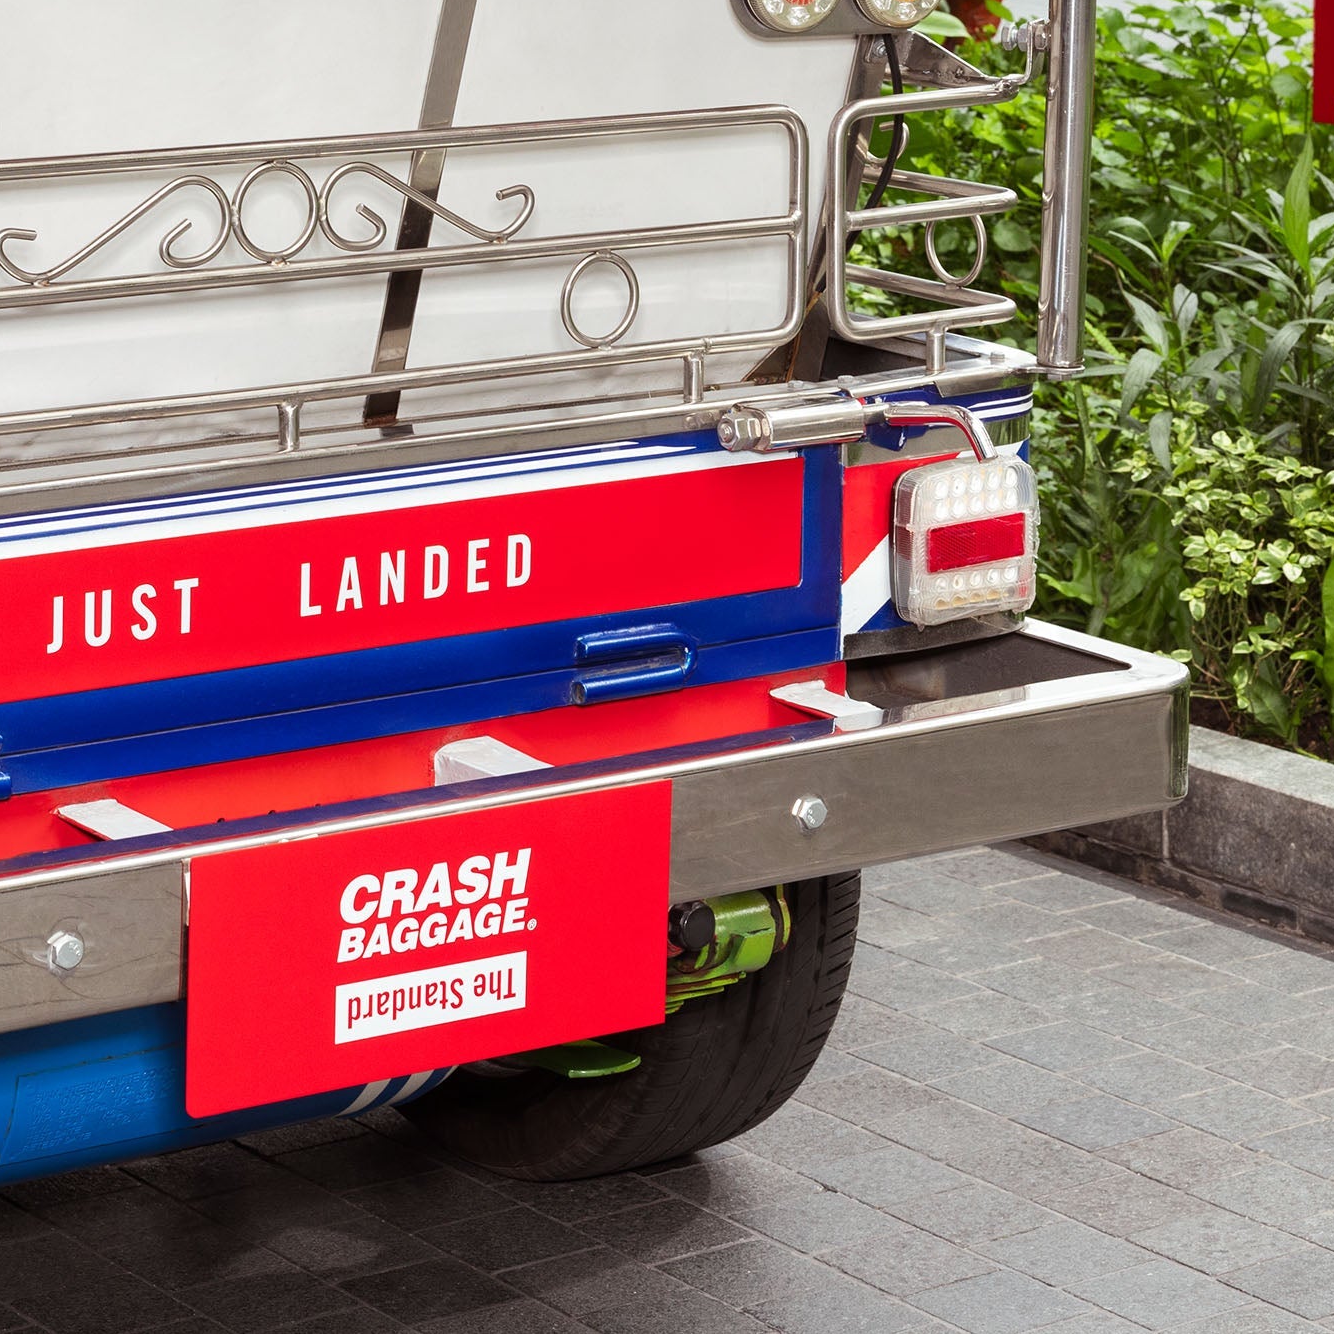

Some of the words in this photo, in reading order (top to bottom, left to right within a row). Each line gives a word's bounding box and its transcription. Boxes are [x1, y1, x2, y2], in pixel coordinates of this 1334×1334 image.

[46, 577, 199, 654] JUST
[300, 533, 533, 617] LANDED
[339, 847, 532, 925] CRASH
[347, 978, 464, 1030] Standard
[473, 968, 517, 1001] The
